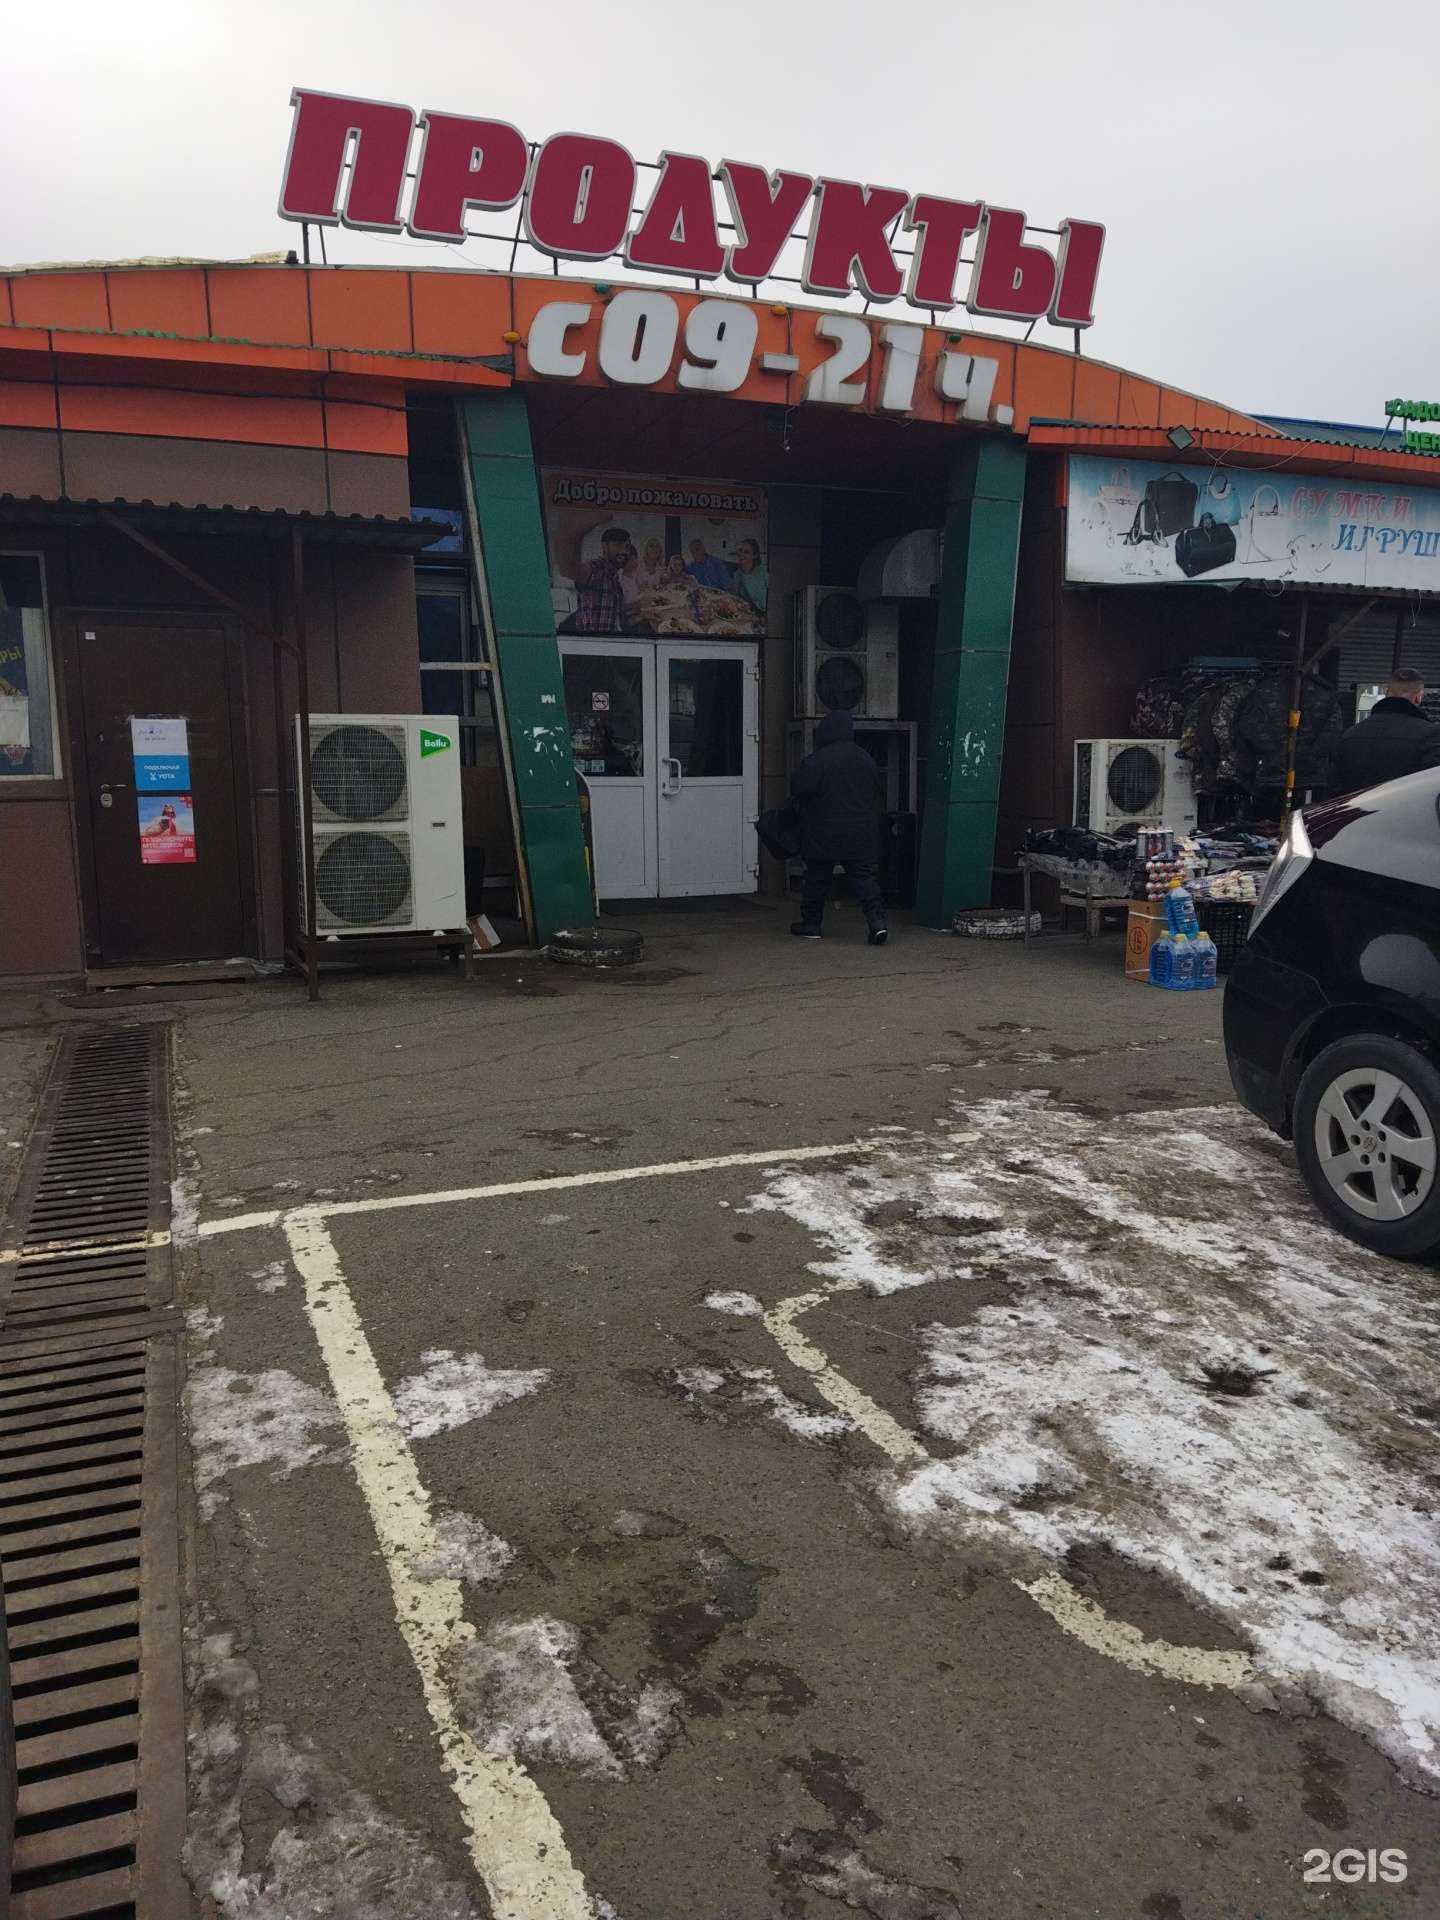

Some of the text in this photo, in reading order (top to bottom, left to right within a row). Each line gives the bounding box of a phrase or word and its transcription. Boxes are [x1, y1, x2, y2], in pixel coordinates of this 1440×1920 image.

[278, 87, 1106, 328] ПРОДУКТЫ
[554, 478, 760, 512] Добро пожаловать
[1289, 486, 1411, 519] СУМКИ
[424, 738, 447, 748] Ballu
